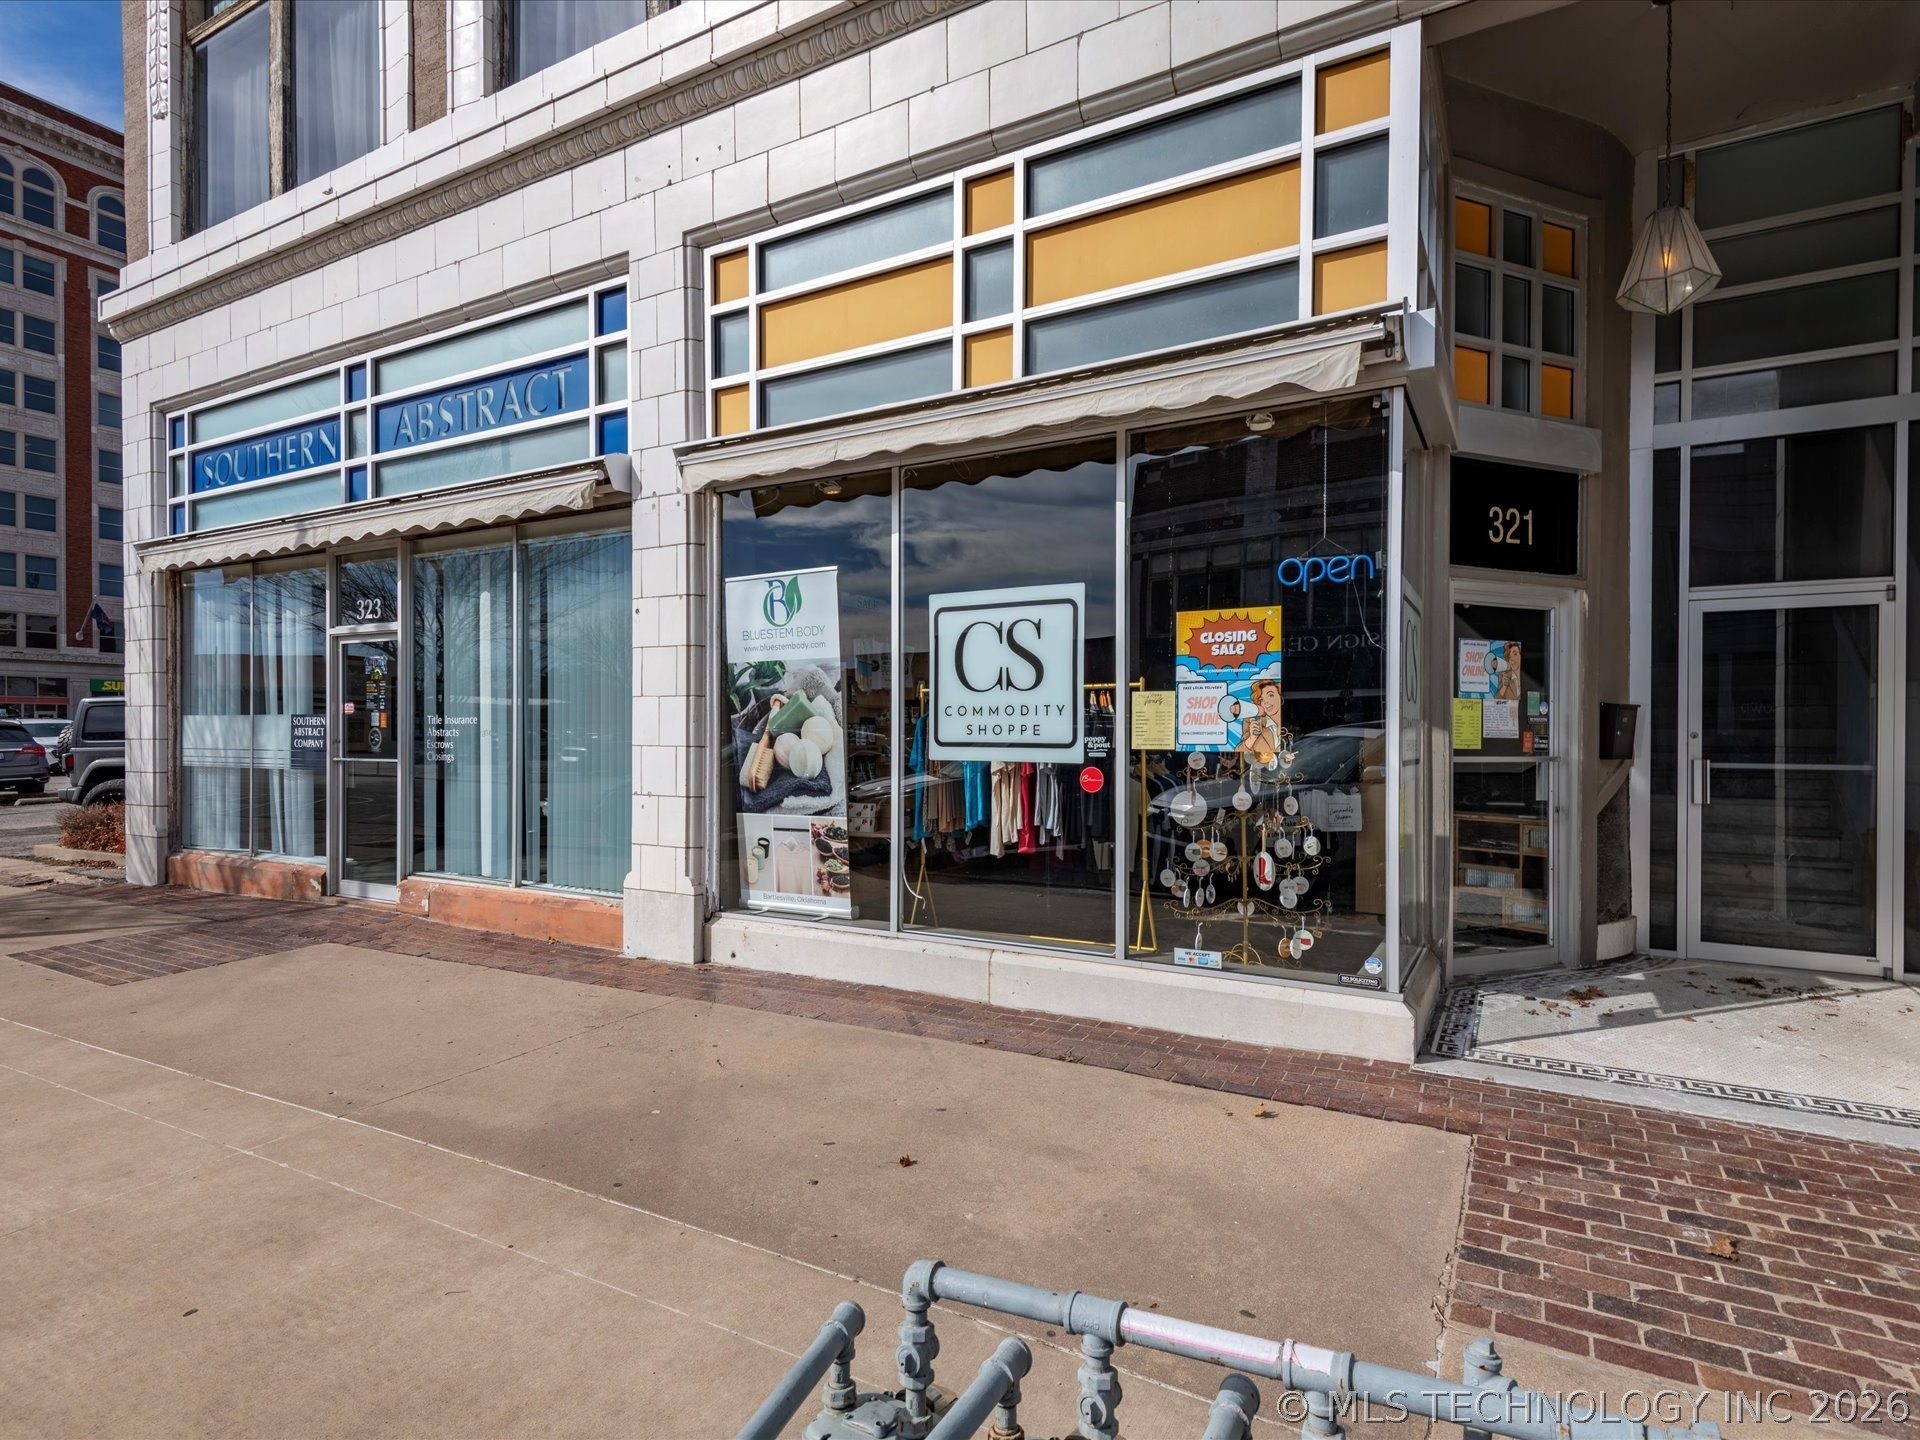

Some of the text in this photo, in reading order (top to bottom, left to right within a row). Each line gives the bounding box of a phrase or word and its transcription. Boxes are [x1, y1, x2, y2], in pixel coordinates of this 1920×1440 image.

[201, 366, 573, 491] SOUTHERN ABSTRACT
[1488, 506, 1534, 545] 321
[1277, 554, 1374, 592] open
[356, 598, 382, 620] 323
[742, 625, 826, 641] BLUESTEM BODY
[1200, 629, 1257, 644] CLOSING
[743, 641, 826, 653] www.bluestembody.com
[954, 618, 1045, 693] CS
[1465, 651, 1485, 663] SHOP
[101, 680, 126, 691] SU
[1186, 695, 1218, 710] SHOP
[944, 704, 1066, 717] COMMODITY
[292, 716, 326, 726] SOUTHERN
[427, 715, 478, 725] Title Insurance
[1182, 712, 1221, 726] ONLINE
[294, 727, 325, 737] ABSTRACT
[427, 728, 460, 737] Abstracts
[966, 724, 1041, 736] SHOPPE
[294, 738, 325, 748] COMPANY
[426, 740, 454, 749] Escrows
[1084, 736, 1107, 744] poppy
[1087, 742, 1111, 750] &pout
[426, 752, 455, 763] Closings
[763, 893, 827, 905] Bartlesville, Oklahoma
